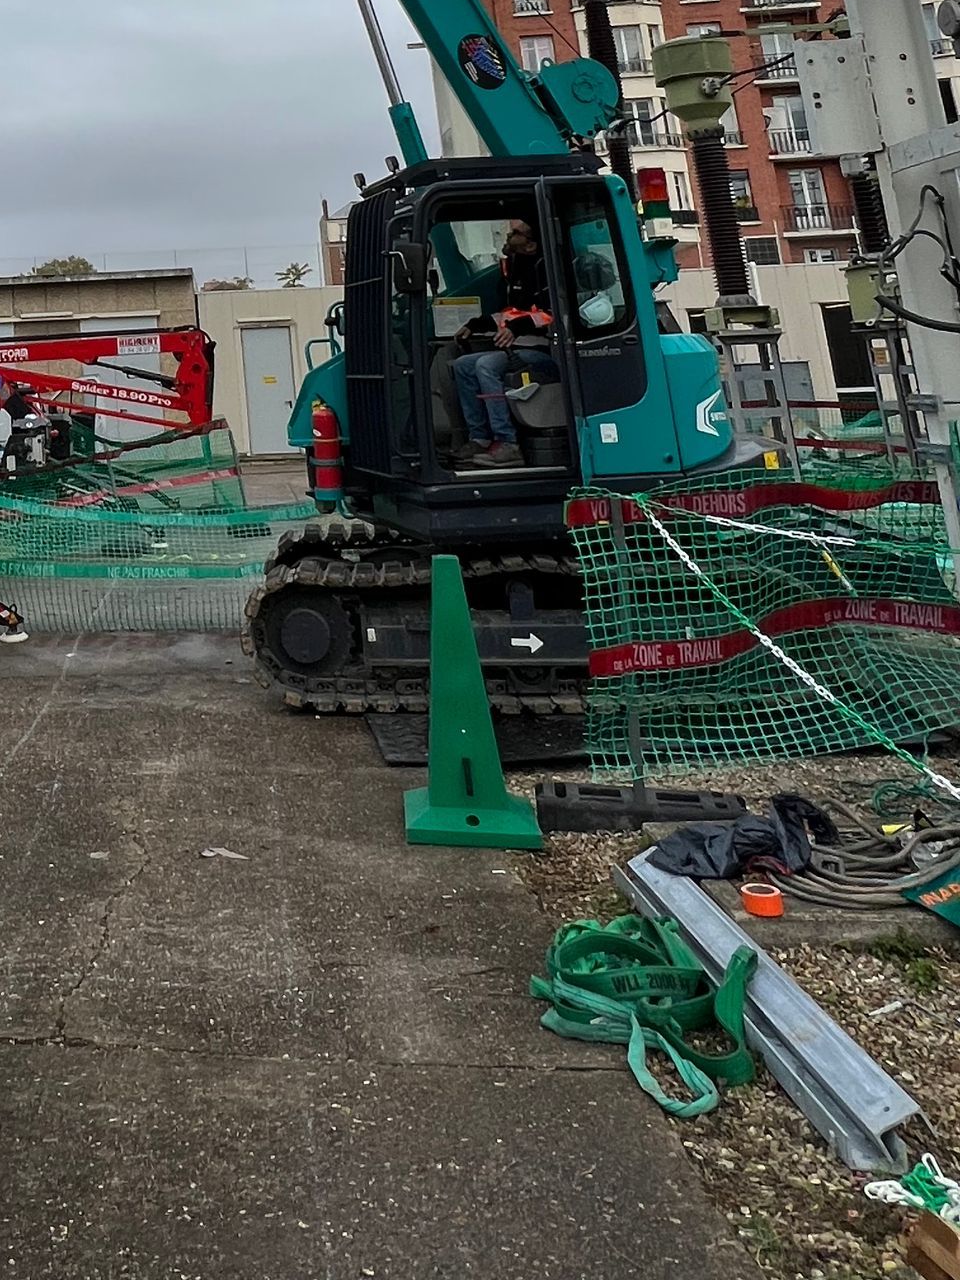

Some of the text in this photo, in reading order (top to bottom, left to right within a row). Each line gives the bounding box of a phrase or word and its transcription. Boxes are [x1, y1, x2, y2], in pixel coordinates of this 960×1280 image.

[71, 381, 171, 406] Spider 18.90 Pro
[692, 493, 746, 515] DEHORS
[122, 566, 139, 578] PAS
[142, 566, 189, 578] FRANCHIR
[845, 600, 876, 619] ZONE
[893, 602, 945, 627] TRAVAIL
[613, 639, 723, 670] DE LA ZONE DE TRAVAIL
